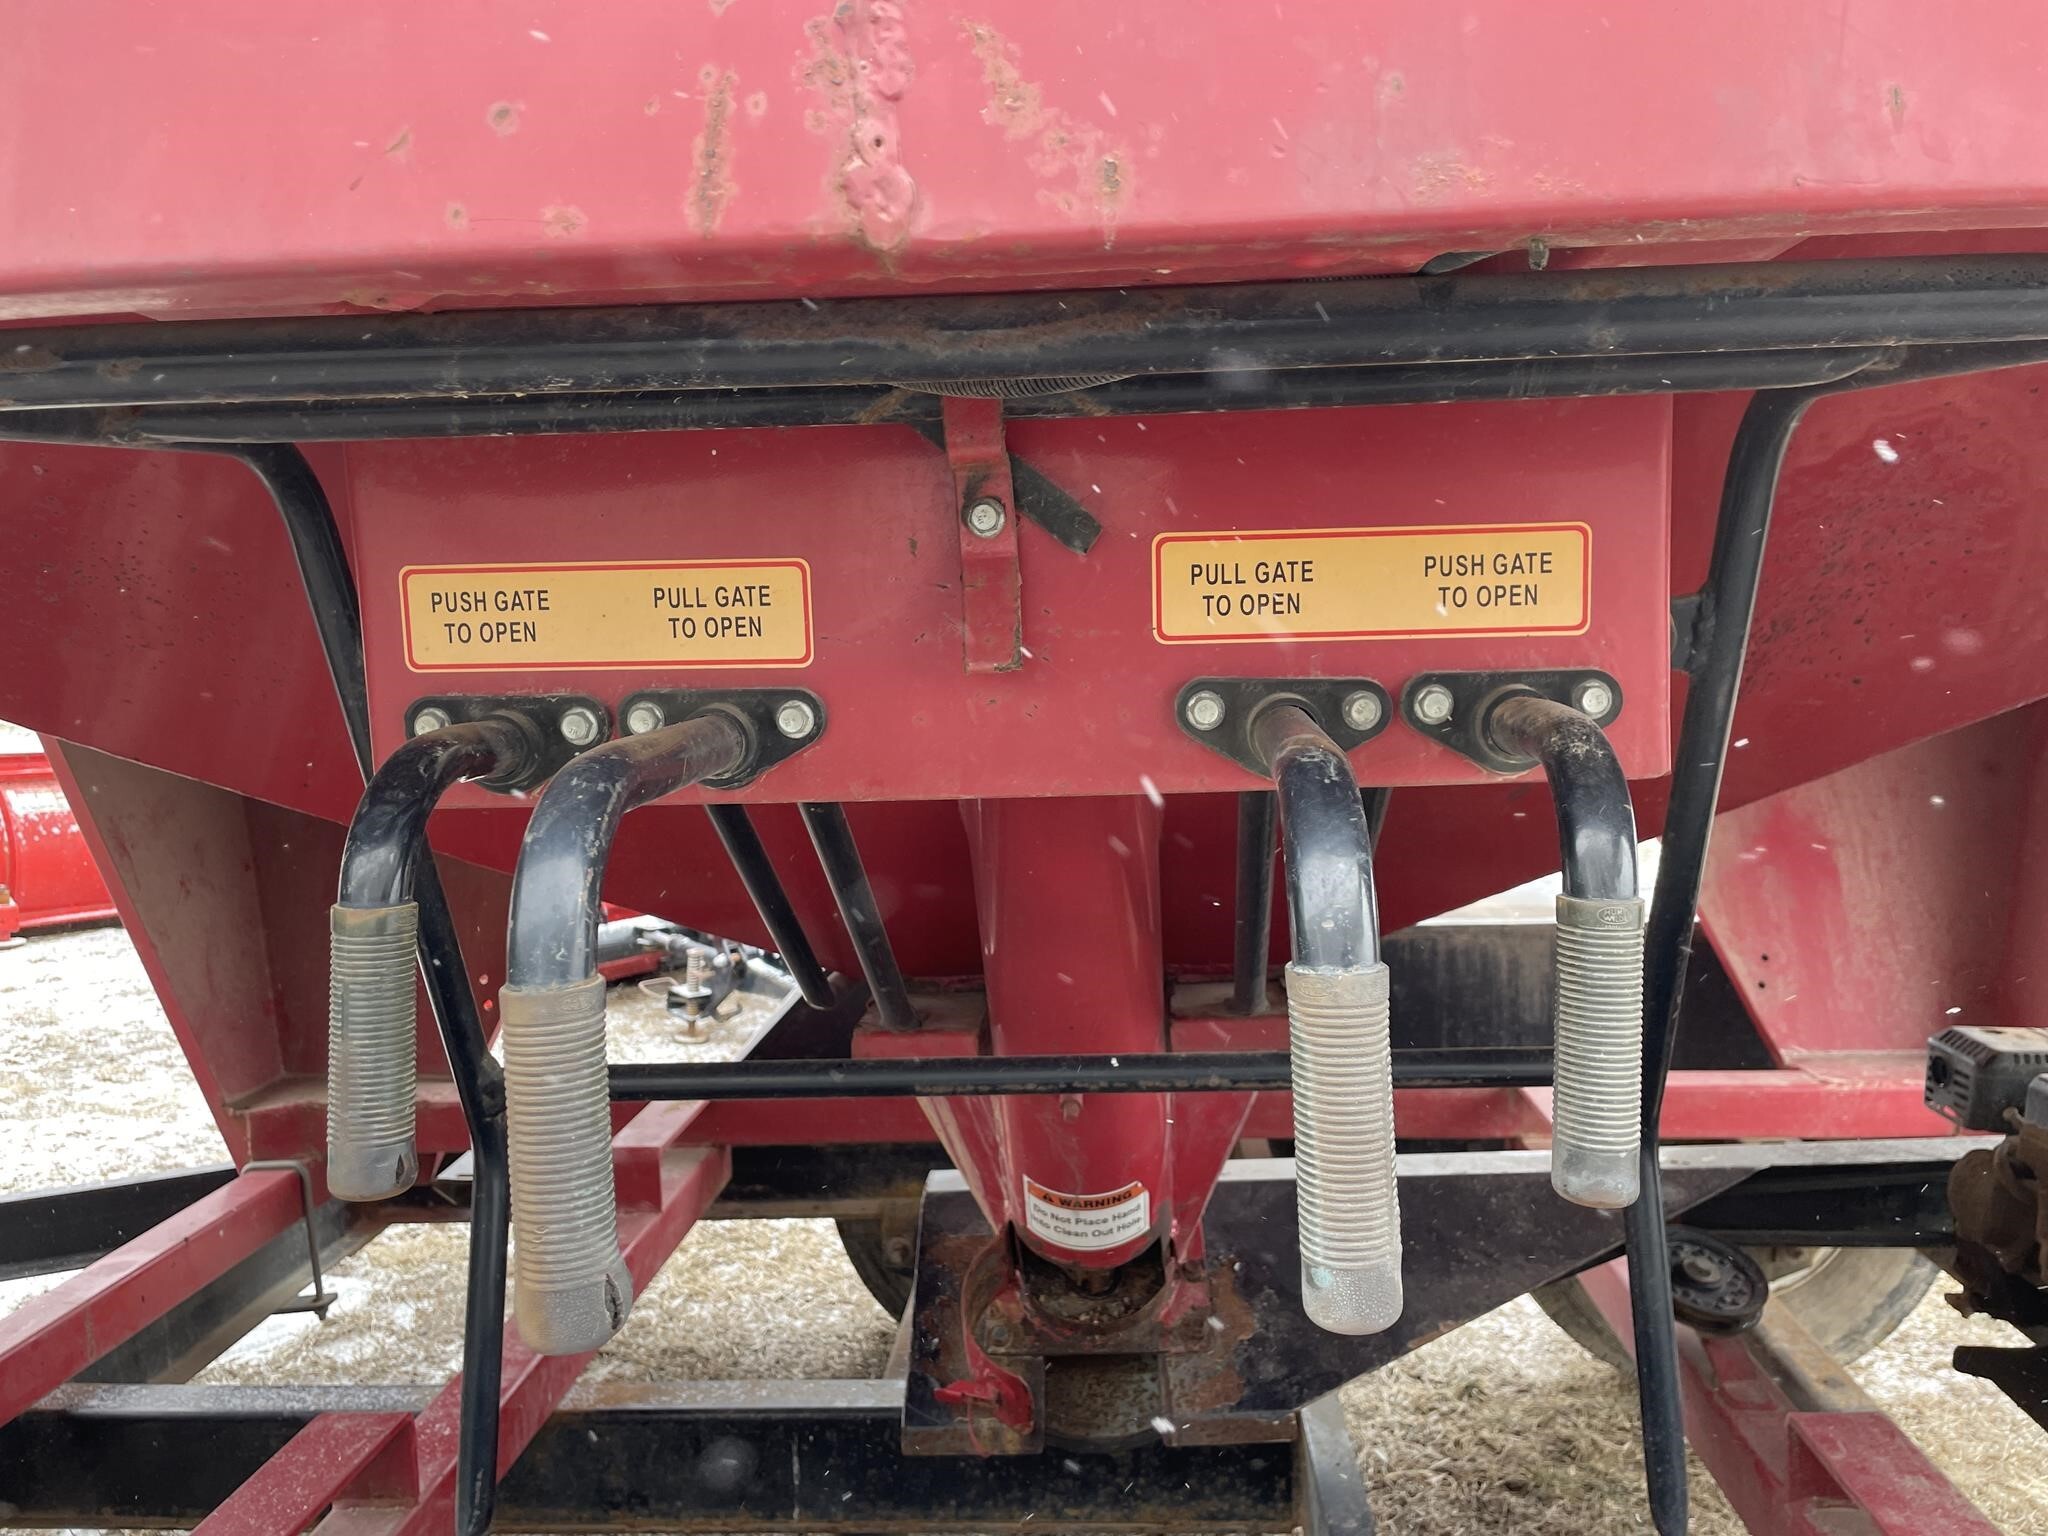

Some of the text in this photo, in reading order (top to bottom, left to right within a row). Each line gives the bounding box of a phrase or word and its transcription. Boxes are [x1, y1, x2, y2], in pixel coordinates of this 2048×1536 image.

[1190, 560, 1314, 586] PULL GATE
[1424, 551, 1553, 577] PUSH GATE
[431, 589, 551, 613] PUSH GATE
[653, 584, 772, 609] PULL GATE
[1202, 592, 1301, 617] TO OPEN
[1438, 584, 1539, 609] TO OPEN
[444, 621, 537, 644] TO OPEN
[668, 615, 763, 639] TO OPEN
[1060, 1190, 1132, 1208] WARNING
[1033, 1203, 1141, 1226] Do Not Place Hand
[1054, 1225, 1088, 1238] Clean
[1091, 1226, 1114, 1238] Out
